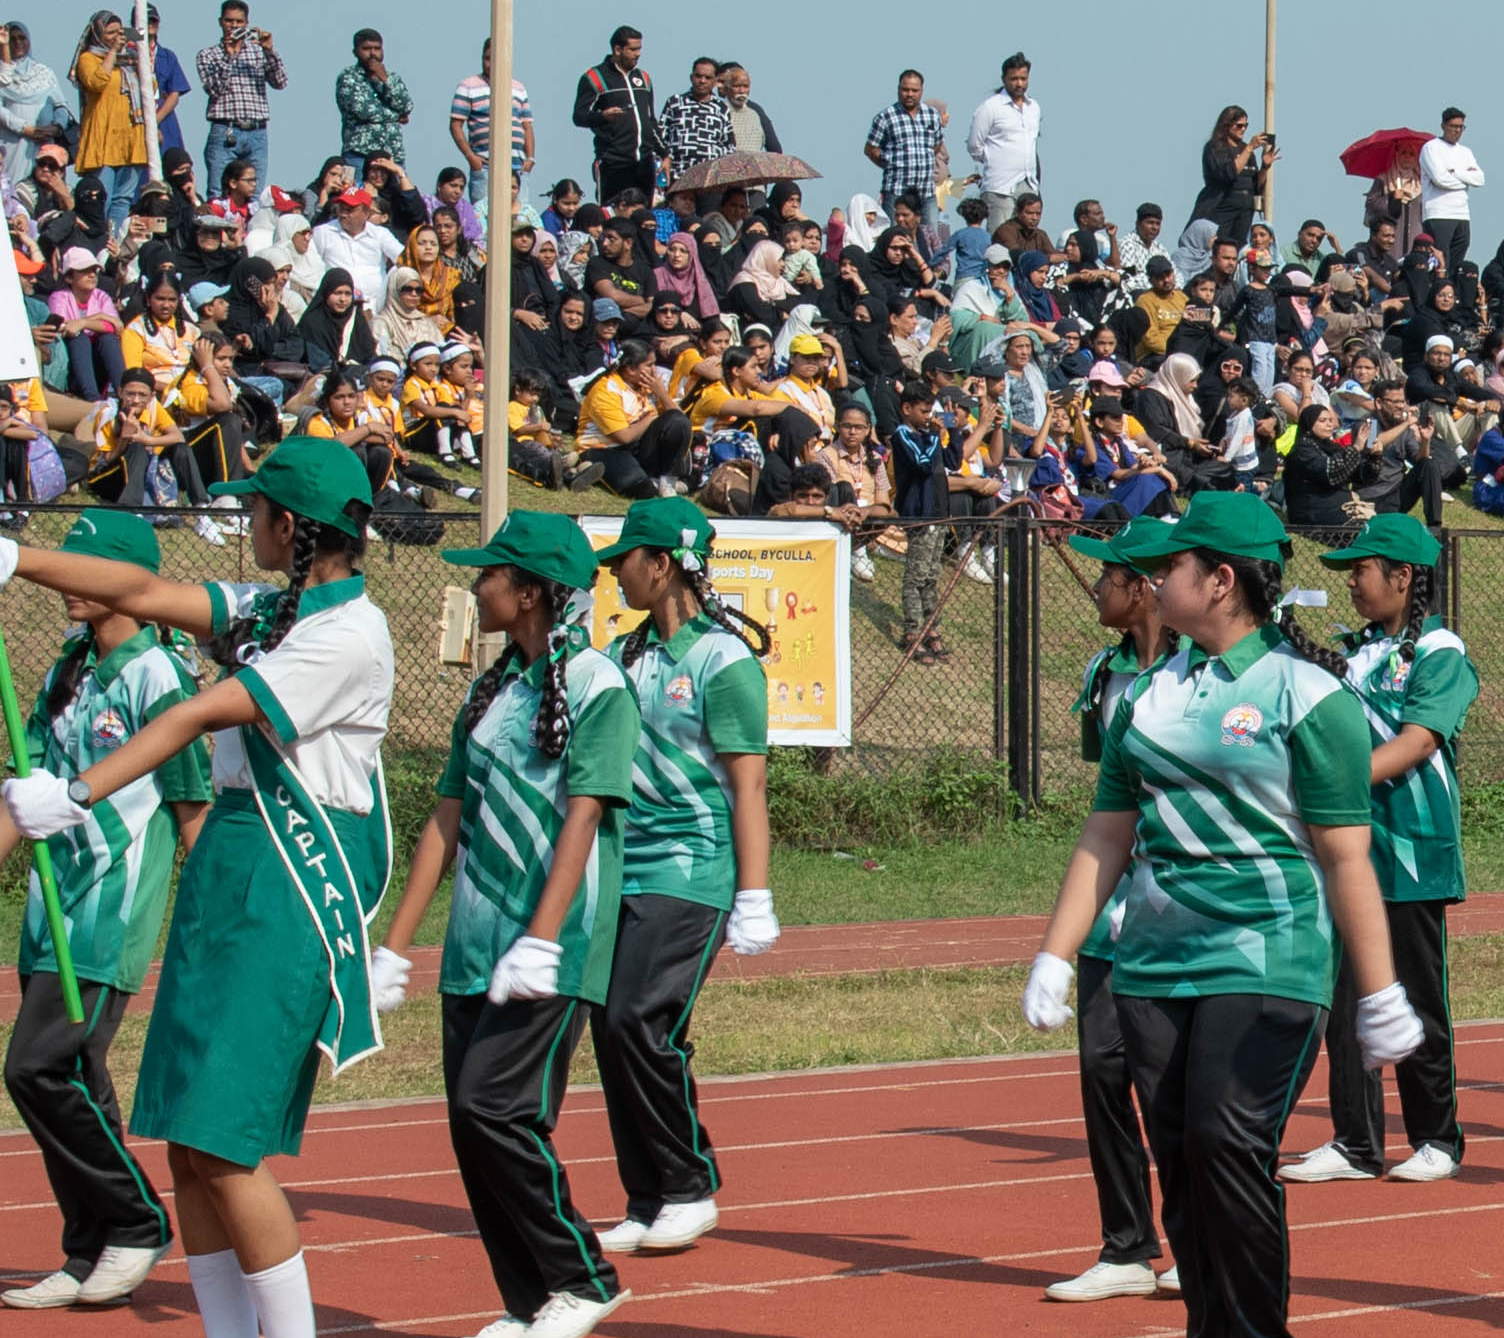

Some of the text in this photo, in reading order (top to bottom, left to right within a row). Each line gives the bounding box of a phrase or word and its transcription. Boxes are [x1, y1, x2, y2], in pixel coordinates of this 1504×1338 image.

[760, 550, 817, 561] BYCULLA.
[709, 565, 774, 582] ports Day
[276, 785, 356, 960] CAPTAIN
